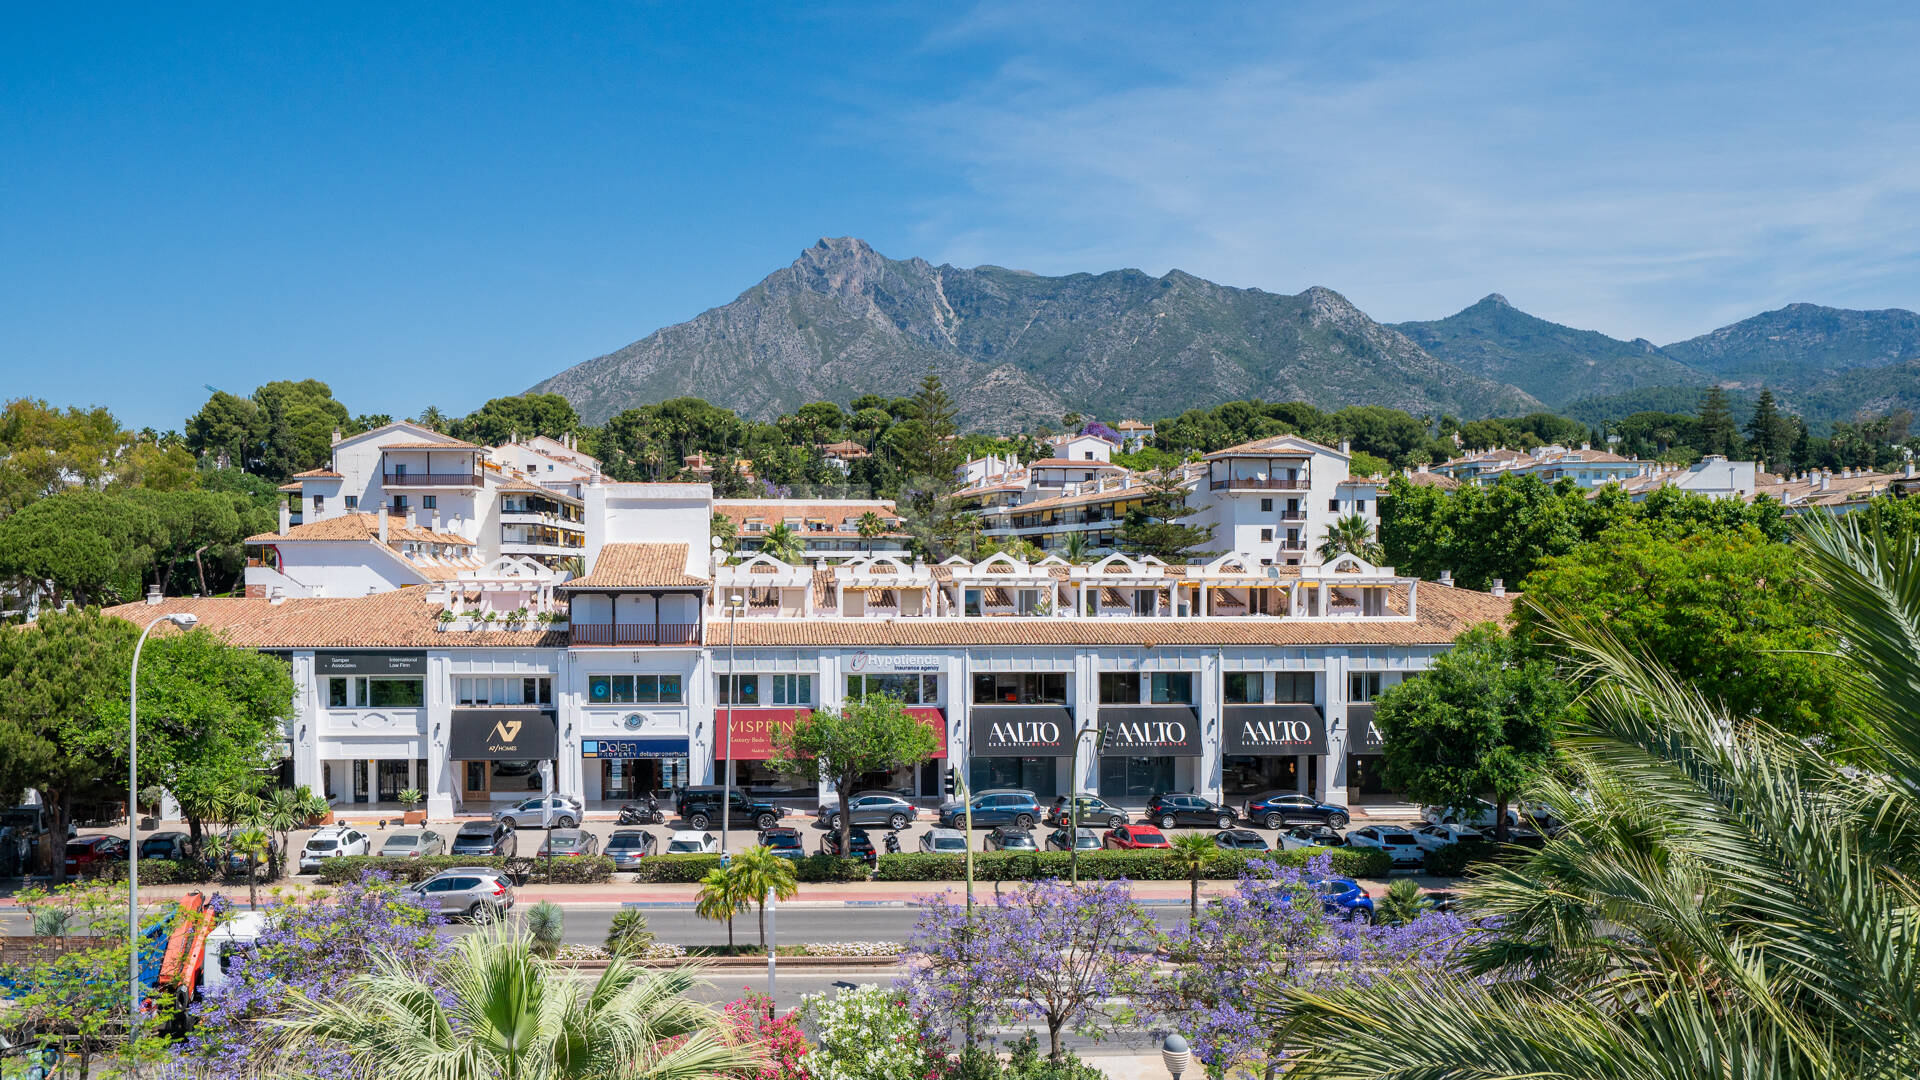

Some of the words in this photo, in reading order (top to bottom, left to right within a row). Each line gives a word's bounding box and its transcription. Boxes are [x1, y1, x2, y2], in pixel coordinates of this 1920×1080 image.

[868, 655, 940, 668] Hypotienda
[988, 721, 1060, 743] AALTO
[1116, 721, 1187, 743] AALTO
[1241, 720, 1311, 742] AALTO
[598, 741, 637, 753] Dolan
